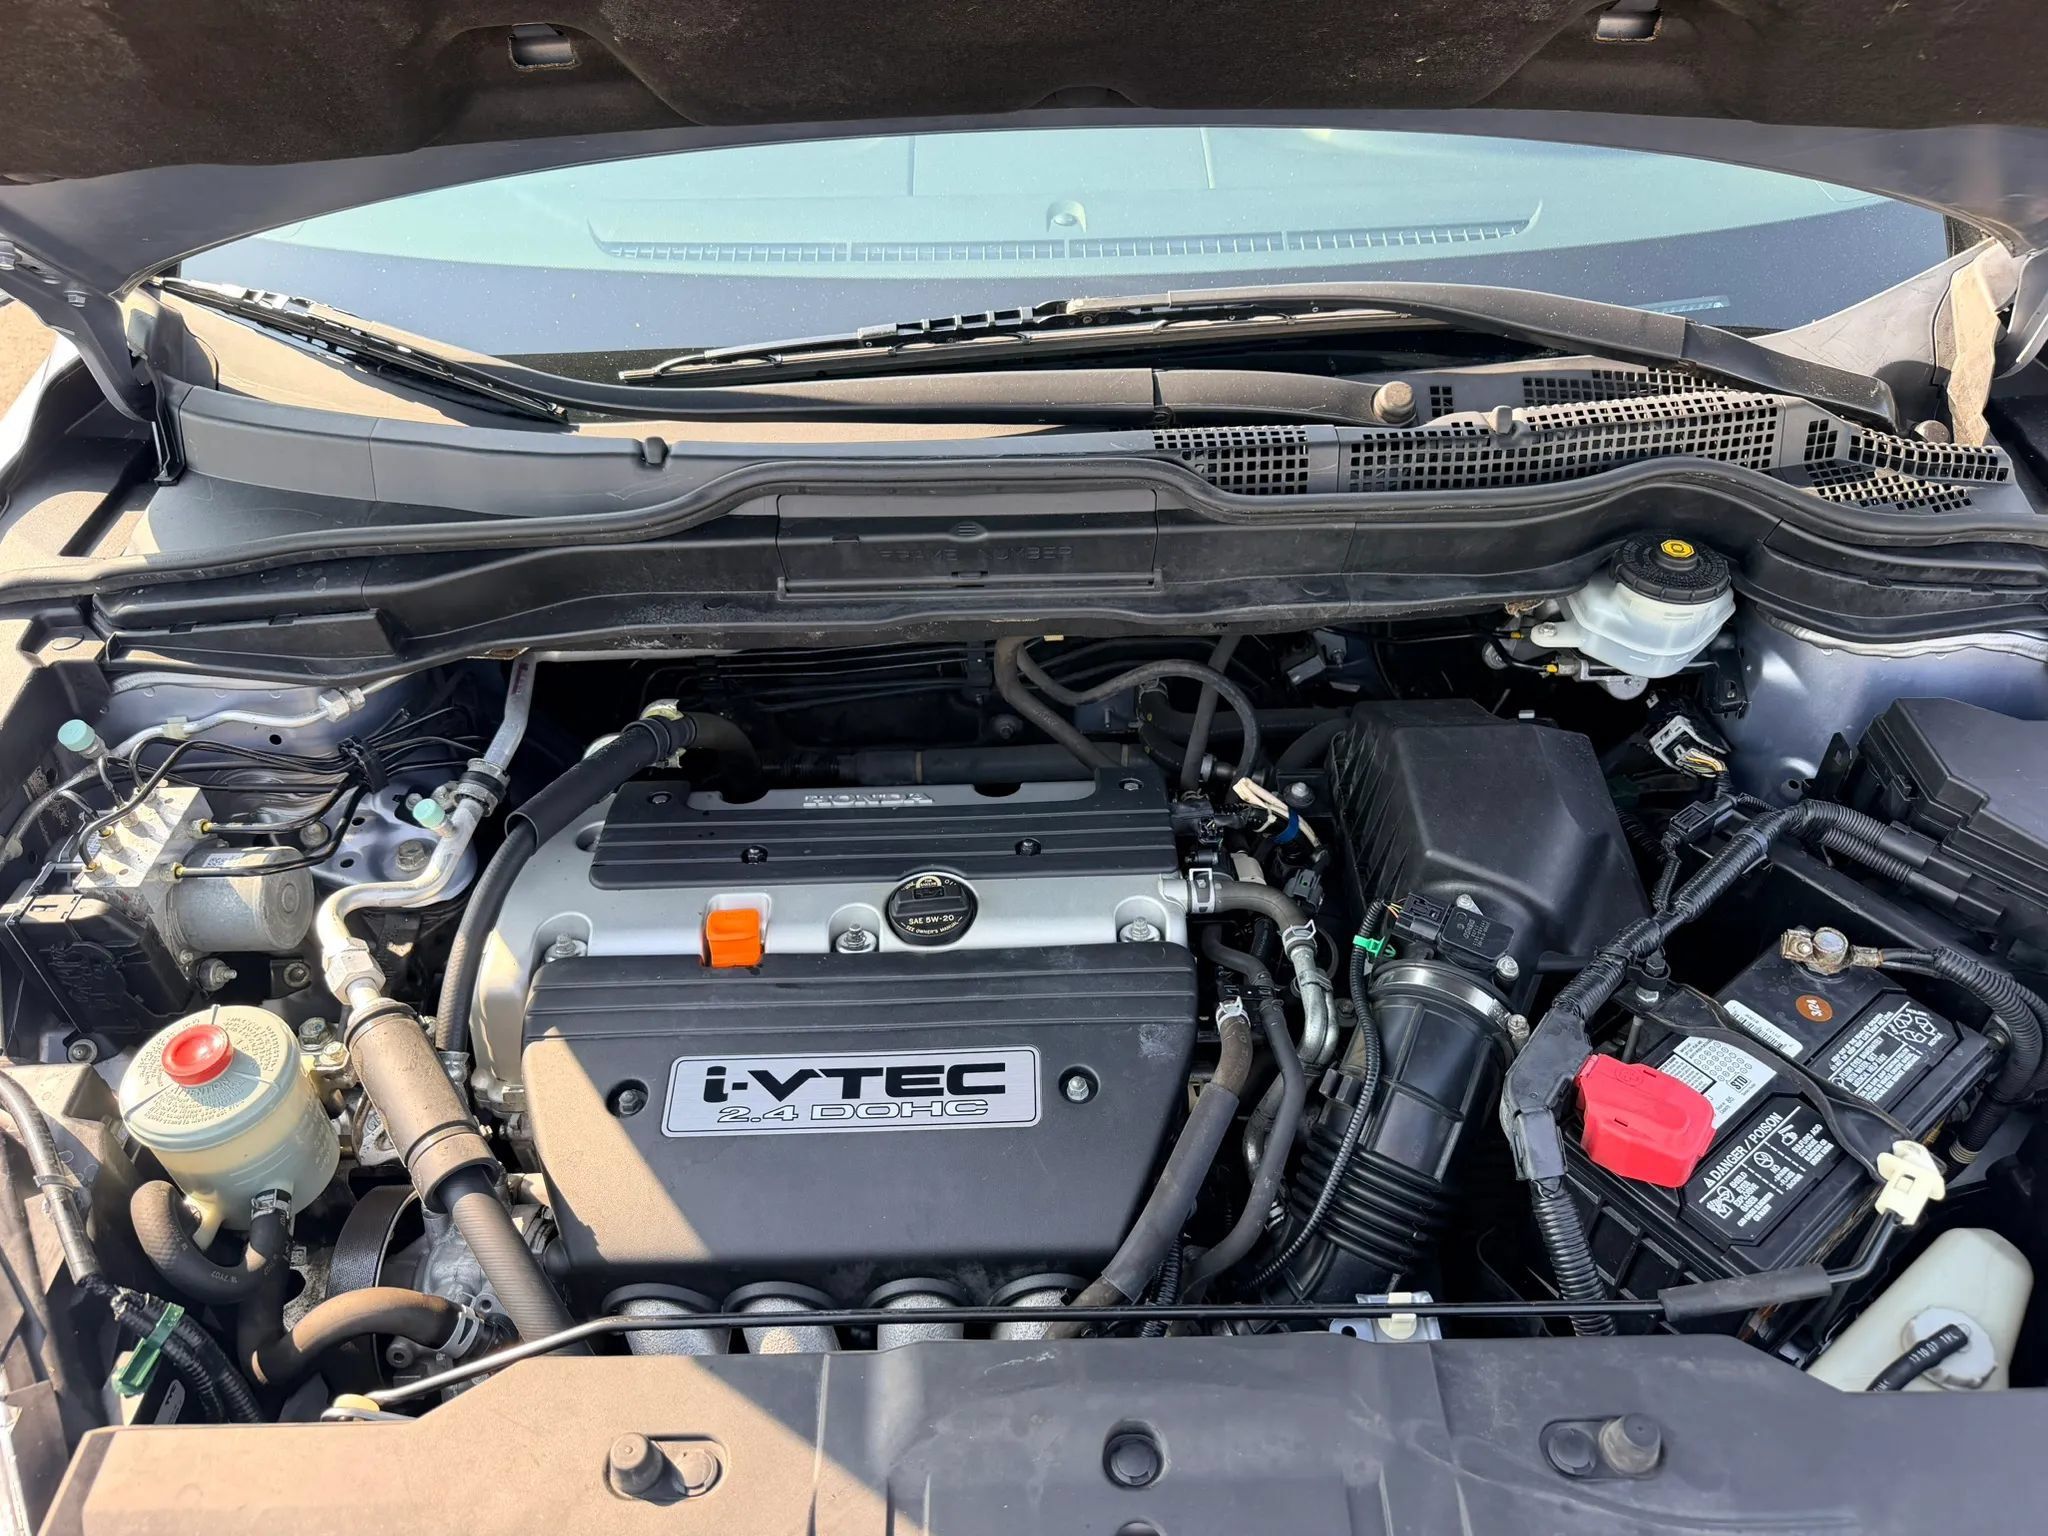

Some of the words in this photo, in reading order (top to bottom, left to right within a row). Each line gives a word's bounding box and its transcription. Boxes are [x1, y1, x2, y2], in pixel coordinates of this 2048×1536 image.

[977, 546, 1073, 560] NUMBER
[803, 792, 935, 808] HONDA
[908, 917, 924, 925] SAE
[926, 914, 954, 924] 5W-20
[703, 1062, 1006, 1103] i-VTEC
[1730, 1075, 1748, 1090] STD
[717, 1104, 799, 1123] 2.4
[810, 1099, 988, 1121] DOHC
[1709, 1145, 1748, 1181] DANGER
[1748, 1112, 1783, 1144] POISON
[1770, 1164, 1781, 1174] NO
[1729, 1171, 1748, 1188] SHIELD
[1736, 1180, 1751, 1193] EYES
[1733, 1183, 1759, 1207] EXPLOSIVE
[1740, 1195, 1758, 1212] GASES
